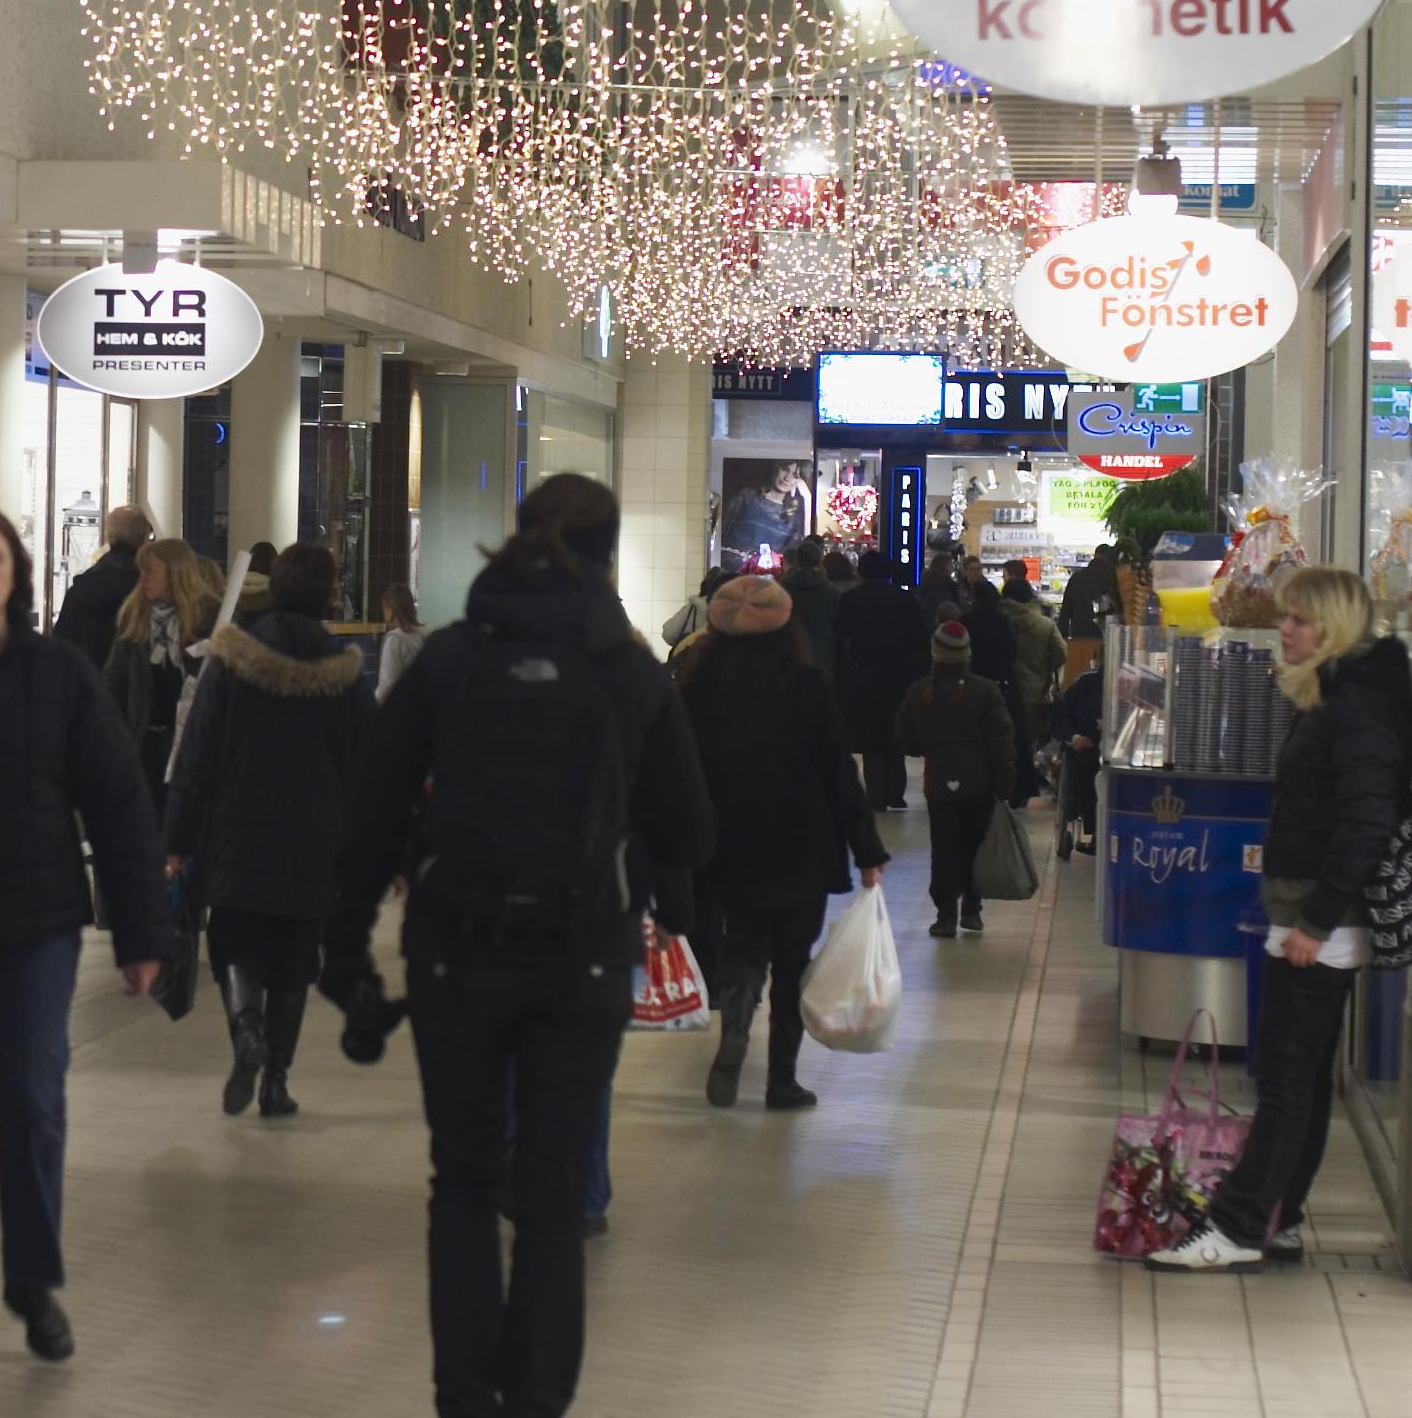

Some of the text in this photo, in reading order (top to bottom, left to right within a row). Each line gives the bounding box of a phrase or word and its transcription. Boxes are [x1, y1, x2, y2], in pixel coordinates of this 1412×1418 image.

[1046, 254, 1169, 290] Godis
[94, 288, 207, 318] TYR
[1100, 293, 1270, 327] Fönstret
[96, 331, 203, 346] HEM & KÖK
[92, 360, 207, 372] PRESENTER
[944, 382, 1006, 420] RIS
[1024, 383, 1116, 422] NY
[1078, 403, 1193, 449] Crispin
[1100, 455, 1164, 468] HANDEL
[900, 474, 911, 565] PARIS
[1133, 829, 1211, 884] Royal
[634, 976, 700, 1005] EXRA
